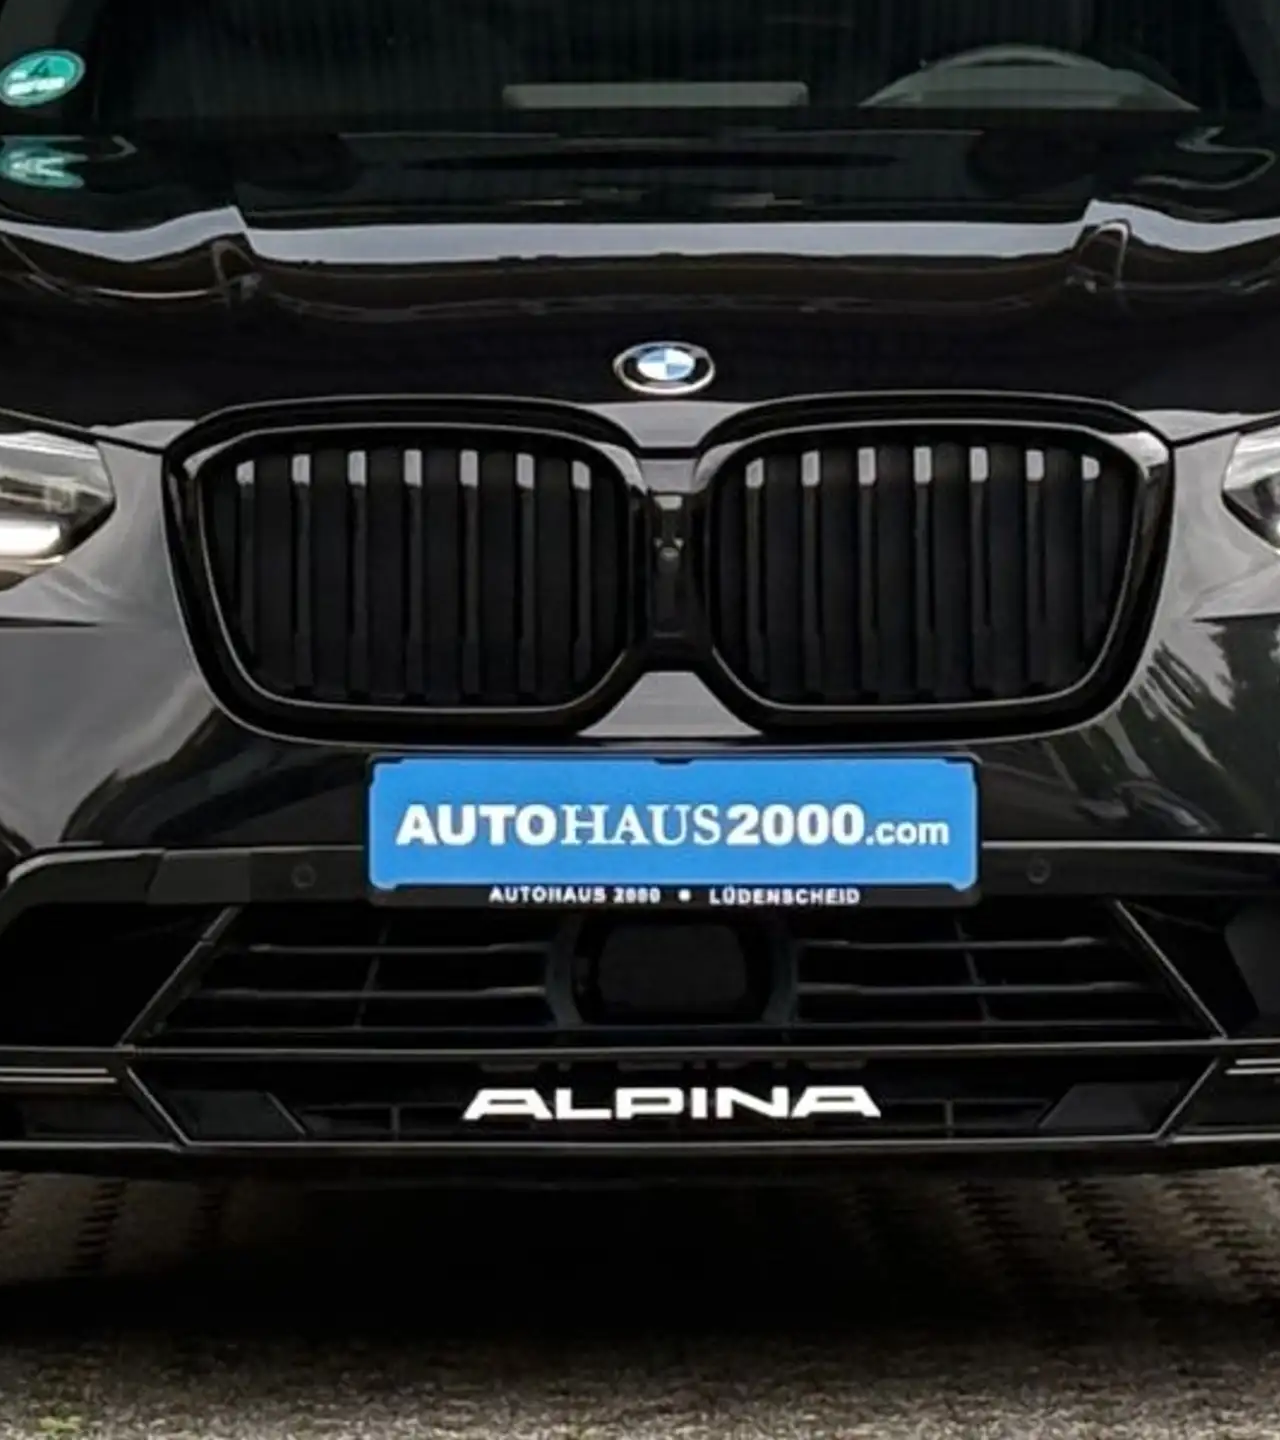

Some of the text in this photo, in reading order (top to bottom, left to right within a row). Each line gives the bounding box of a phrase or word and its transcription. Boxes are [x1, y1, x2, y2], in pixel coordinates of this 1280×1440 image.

[396, 803, 950, 846] AUTOHAUS2000.com
[489, 885, 605, 903] AUTOHAUS
[709, 885, 861, 905] LÜDENSCHEID
[463, 1086, 882, 1120] ALPINA
